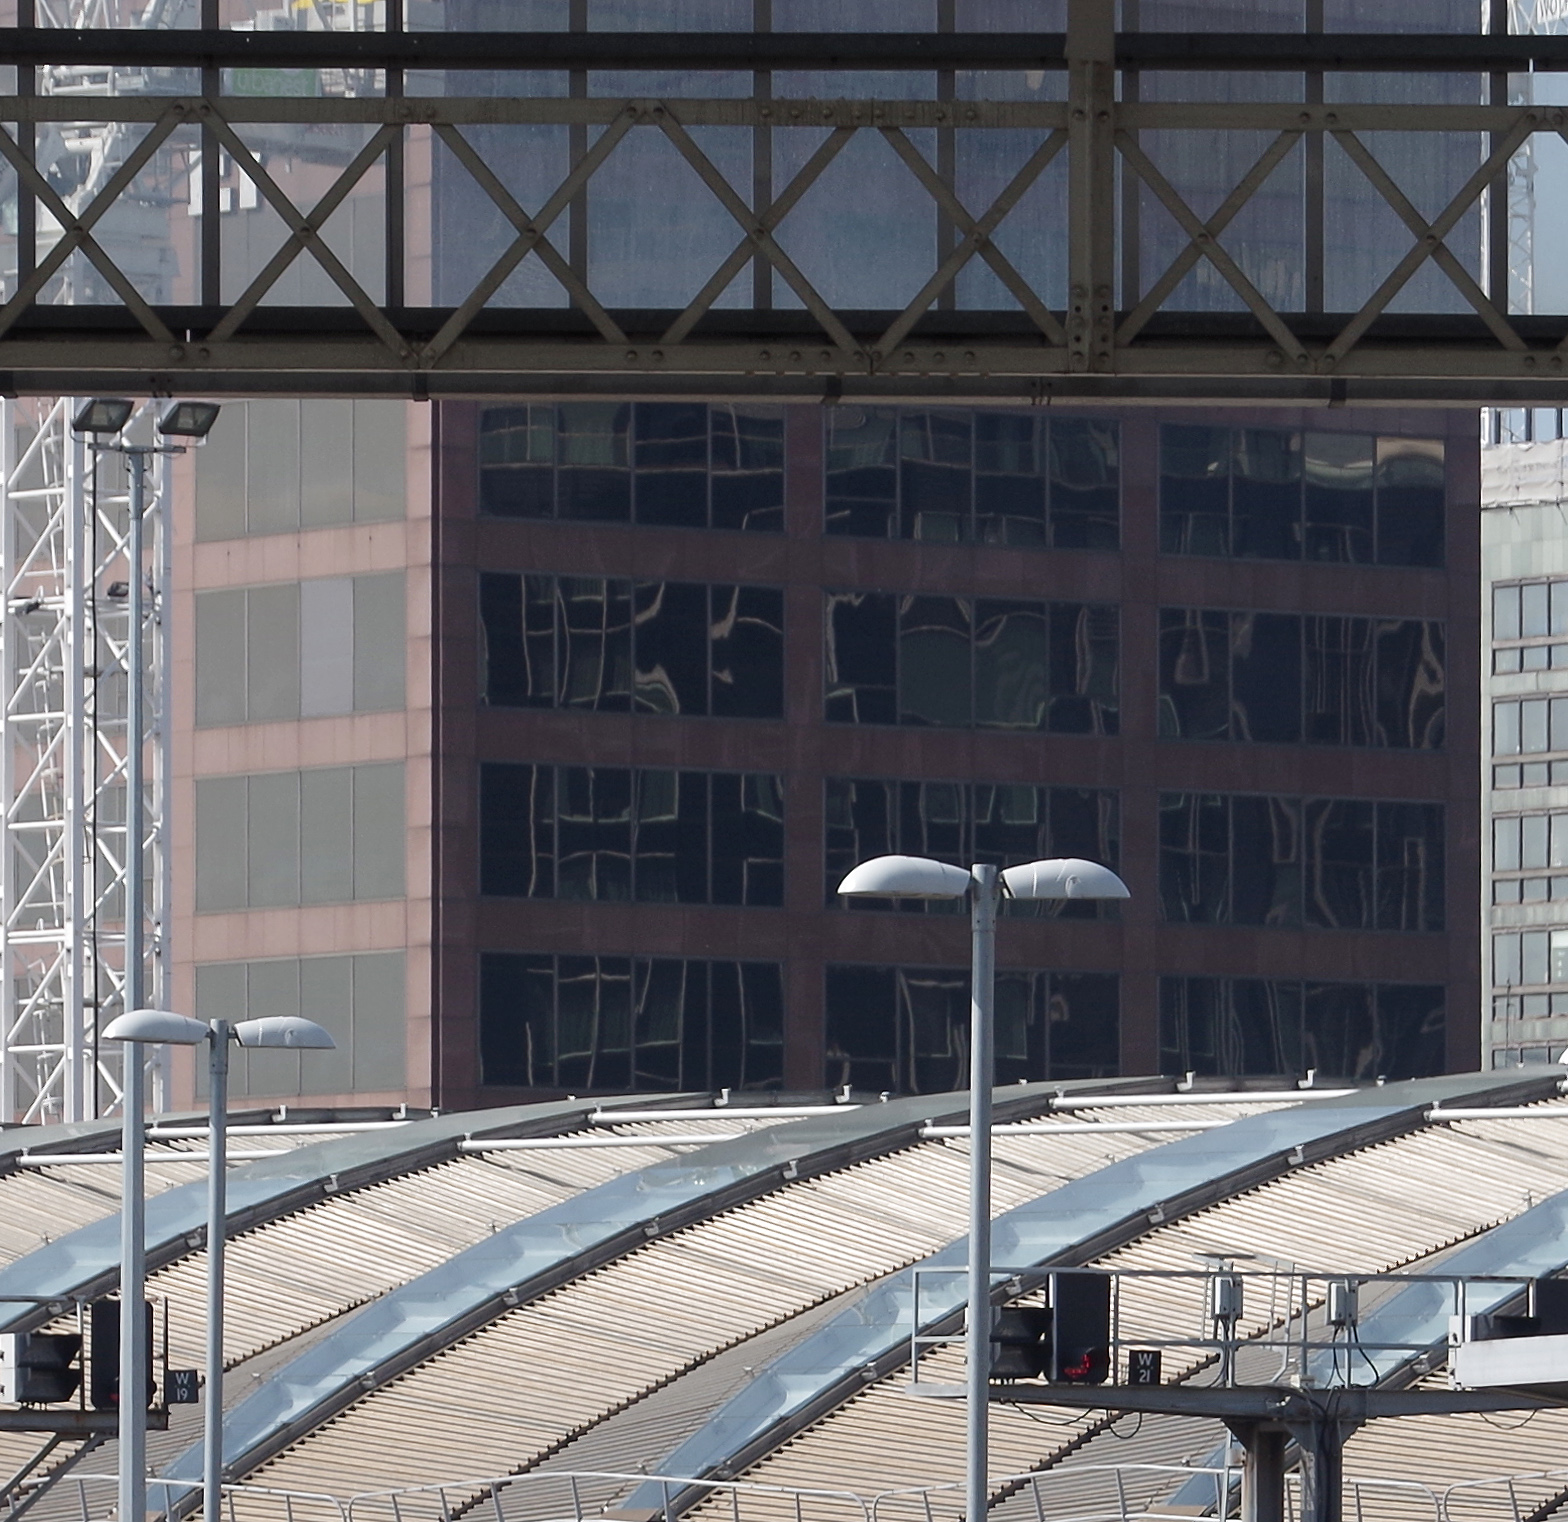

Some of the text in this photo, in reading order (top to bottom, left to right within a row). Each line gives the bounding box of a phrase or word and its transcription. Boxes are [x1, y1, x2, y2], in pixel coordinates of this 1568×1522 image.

[1138, 1353, 1152, 1366] W
[175, 1372, 189, 1385] W
[177, 1388, 188, 1401] 19
